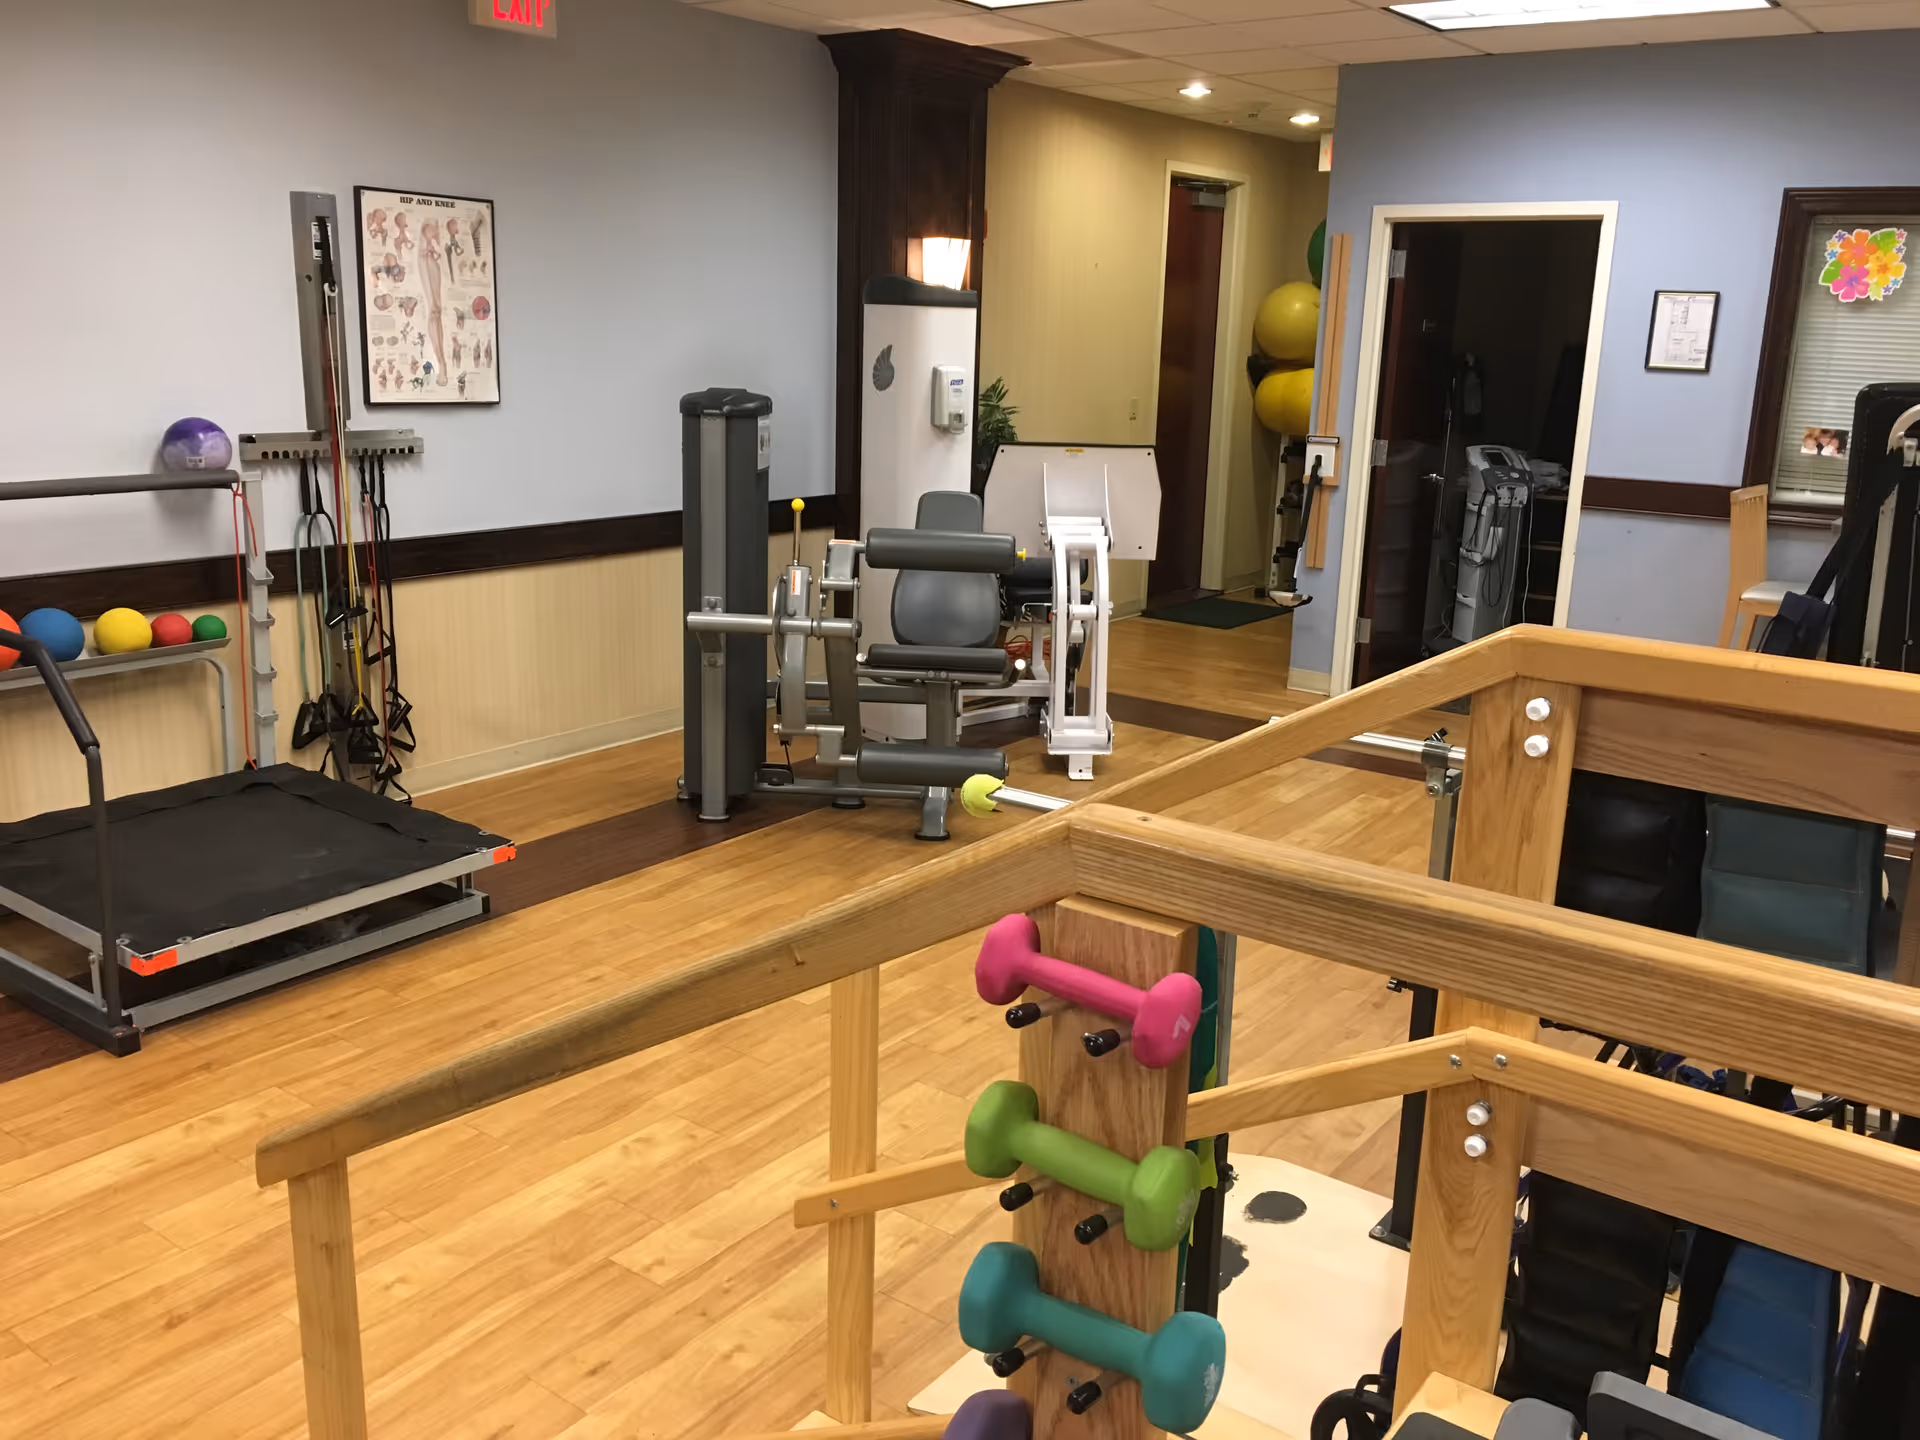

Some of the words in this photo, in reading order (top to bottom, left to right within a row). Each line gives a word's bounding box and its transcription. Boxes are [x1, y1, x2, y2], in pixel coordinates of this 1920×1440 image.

[399, 196, 414, 204] HIP
[416, 198, 433, 206] AND
[434, 200, 456, 209] KNEE
